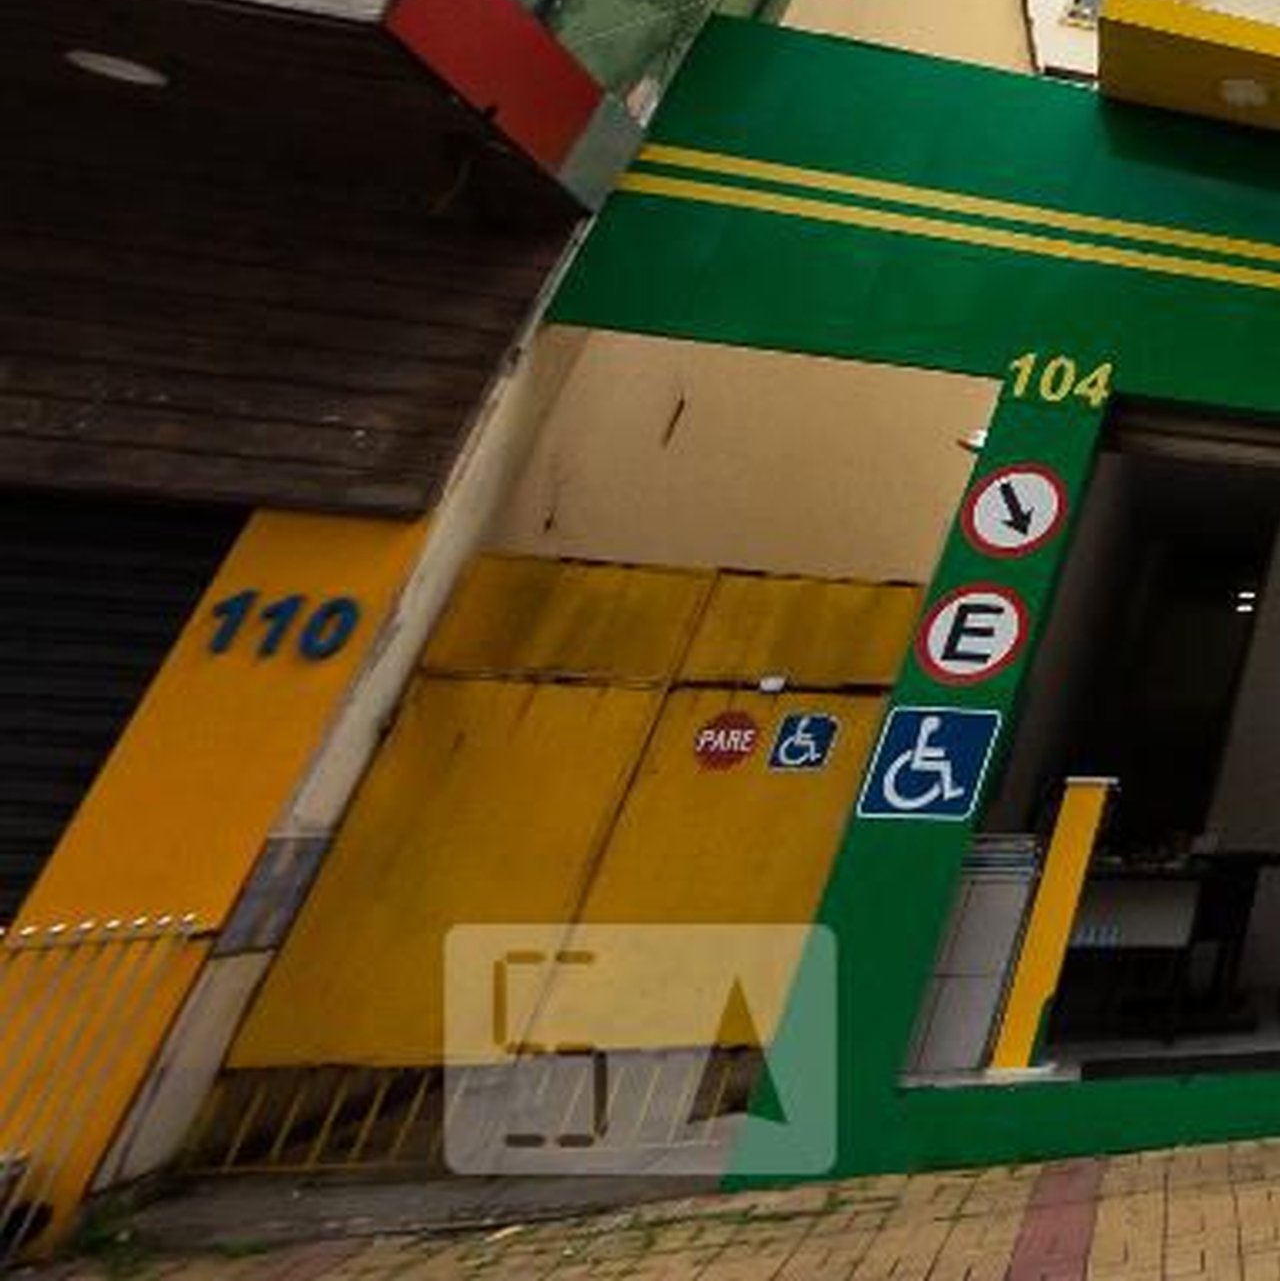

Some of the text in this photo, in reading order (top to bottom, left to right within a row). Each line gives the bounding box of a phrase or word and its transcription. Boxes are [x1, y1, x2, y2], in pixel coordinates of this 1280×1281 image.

[1009, 351, 1113, 408] 104
[209, 589, 362, 663] 110
[941, 603, 1005, 664] E
[696, 728, 757, 754] PARE
